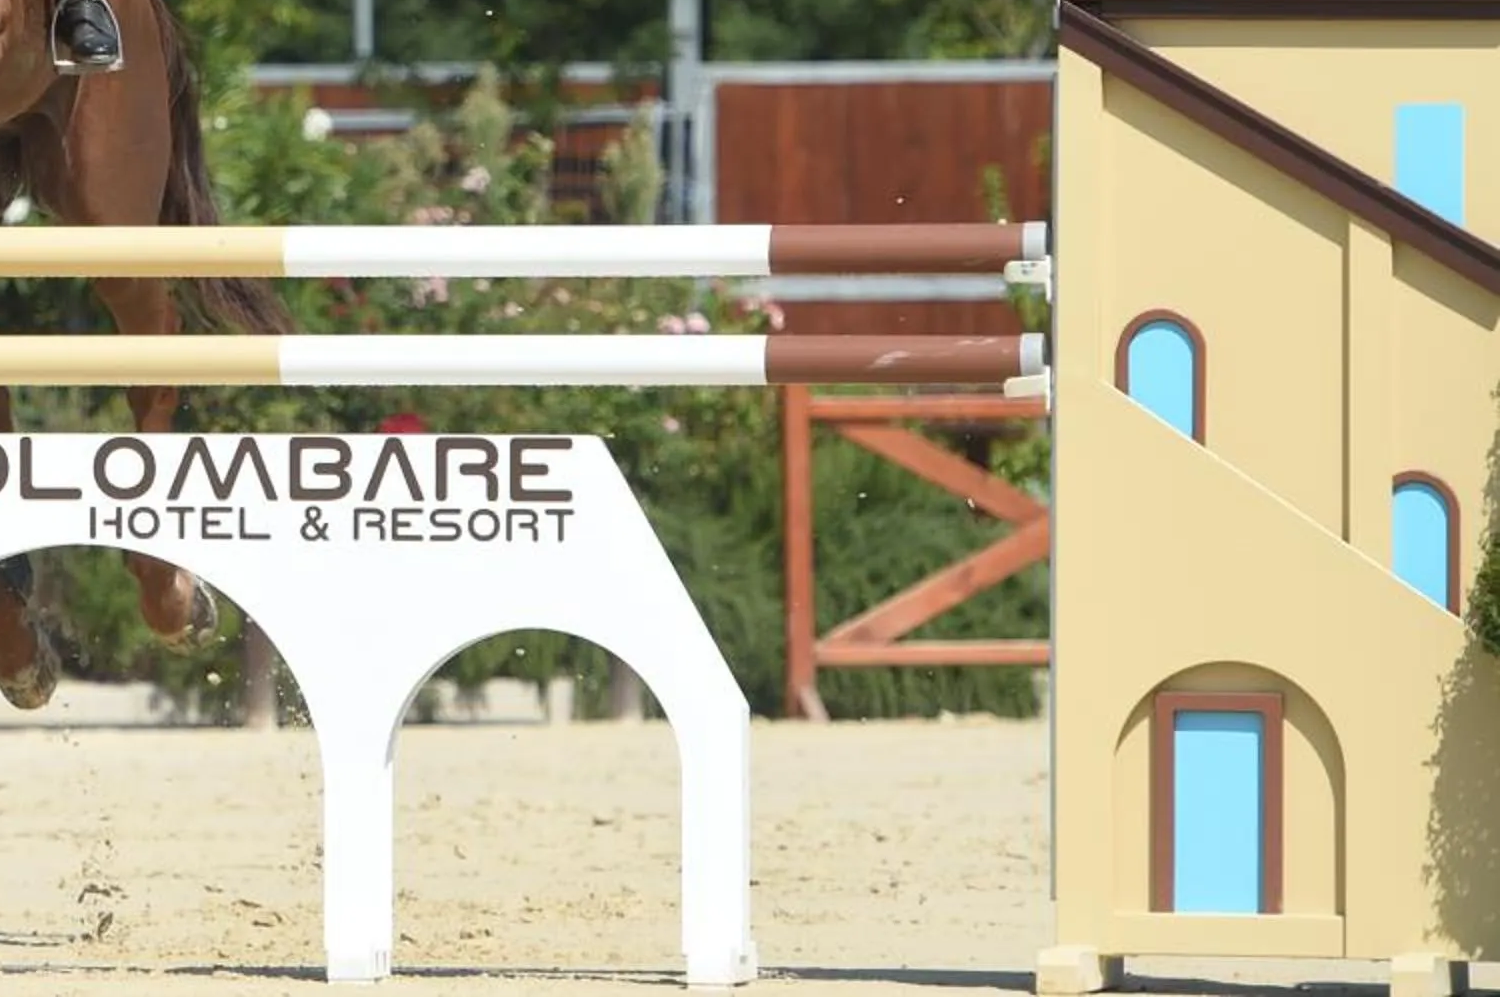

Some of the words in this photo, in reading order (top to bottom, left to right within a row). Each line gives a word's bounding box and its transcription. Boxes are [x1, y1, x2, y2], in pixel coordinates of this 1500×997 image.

[89, 506, 272, 542] HOTEL
[299, 505, 329, 542] &
[353, 507, 575, 543] RESORT
